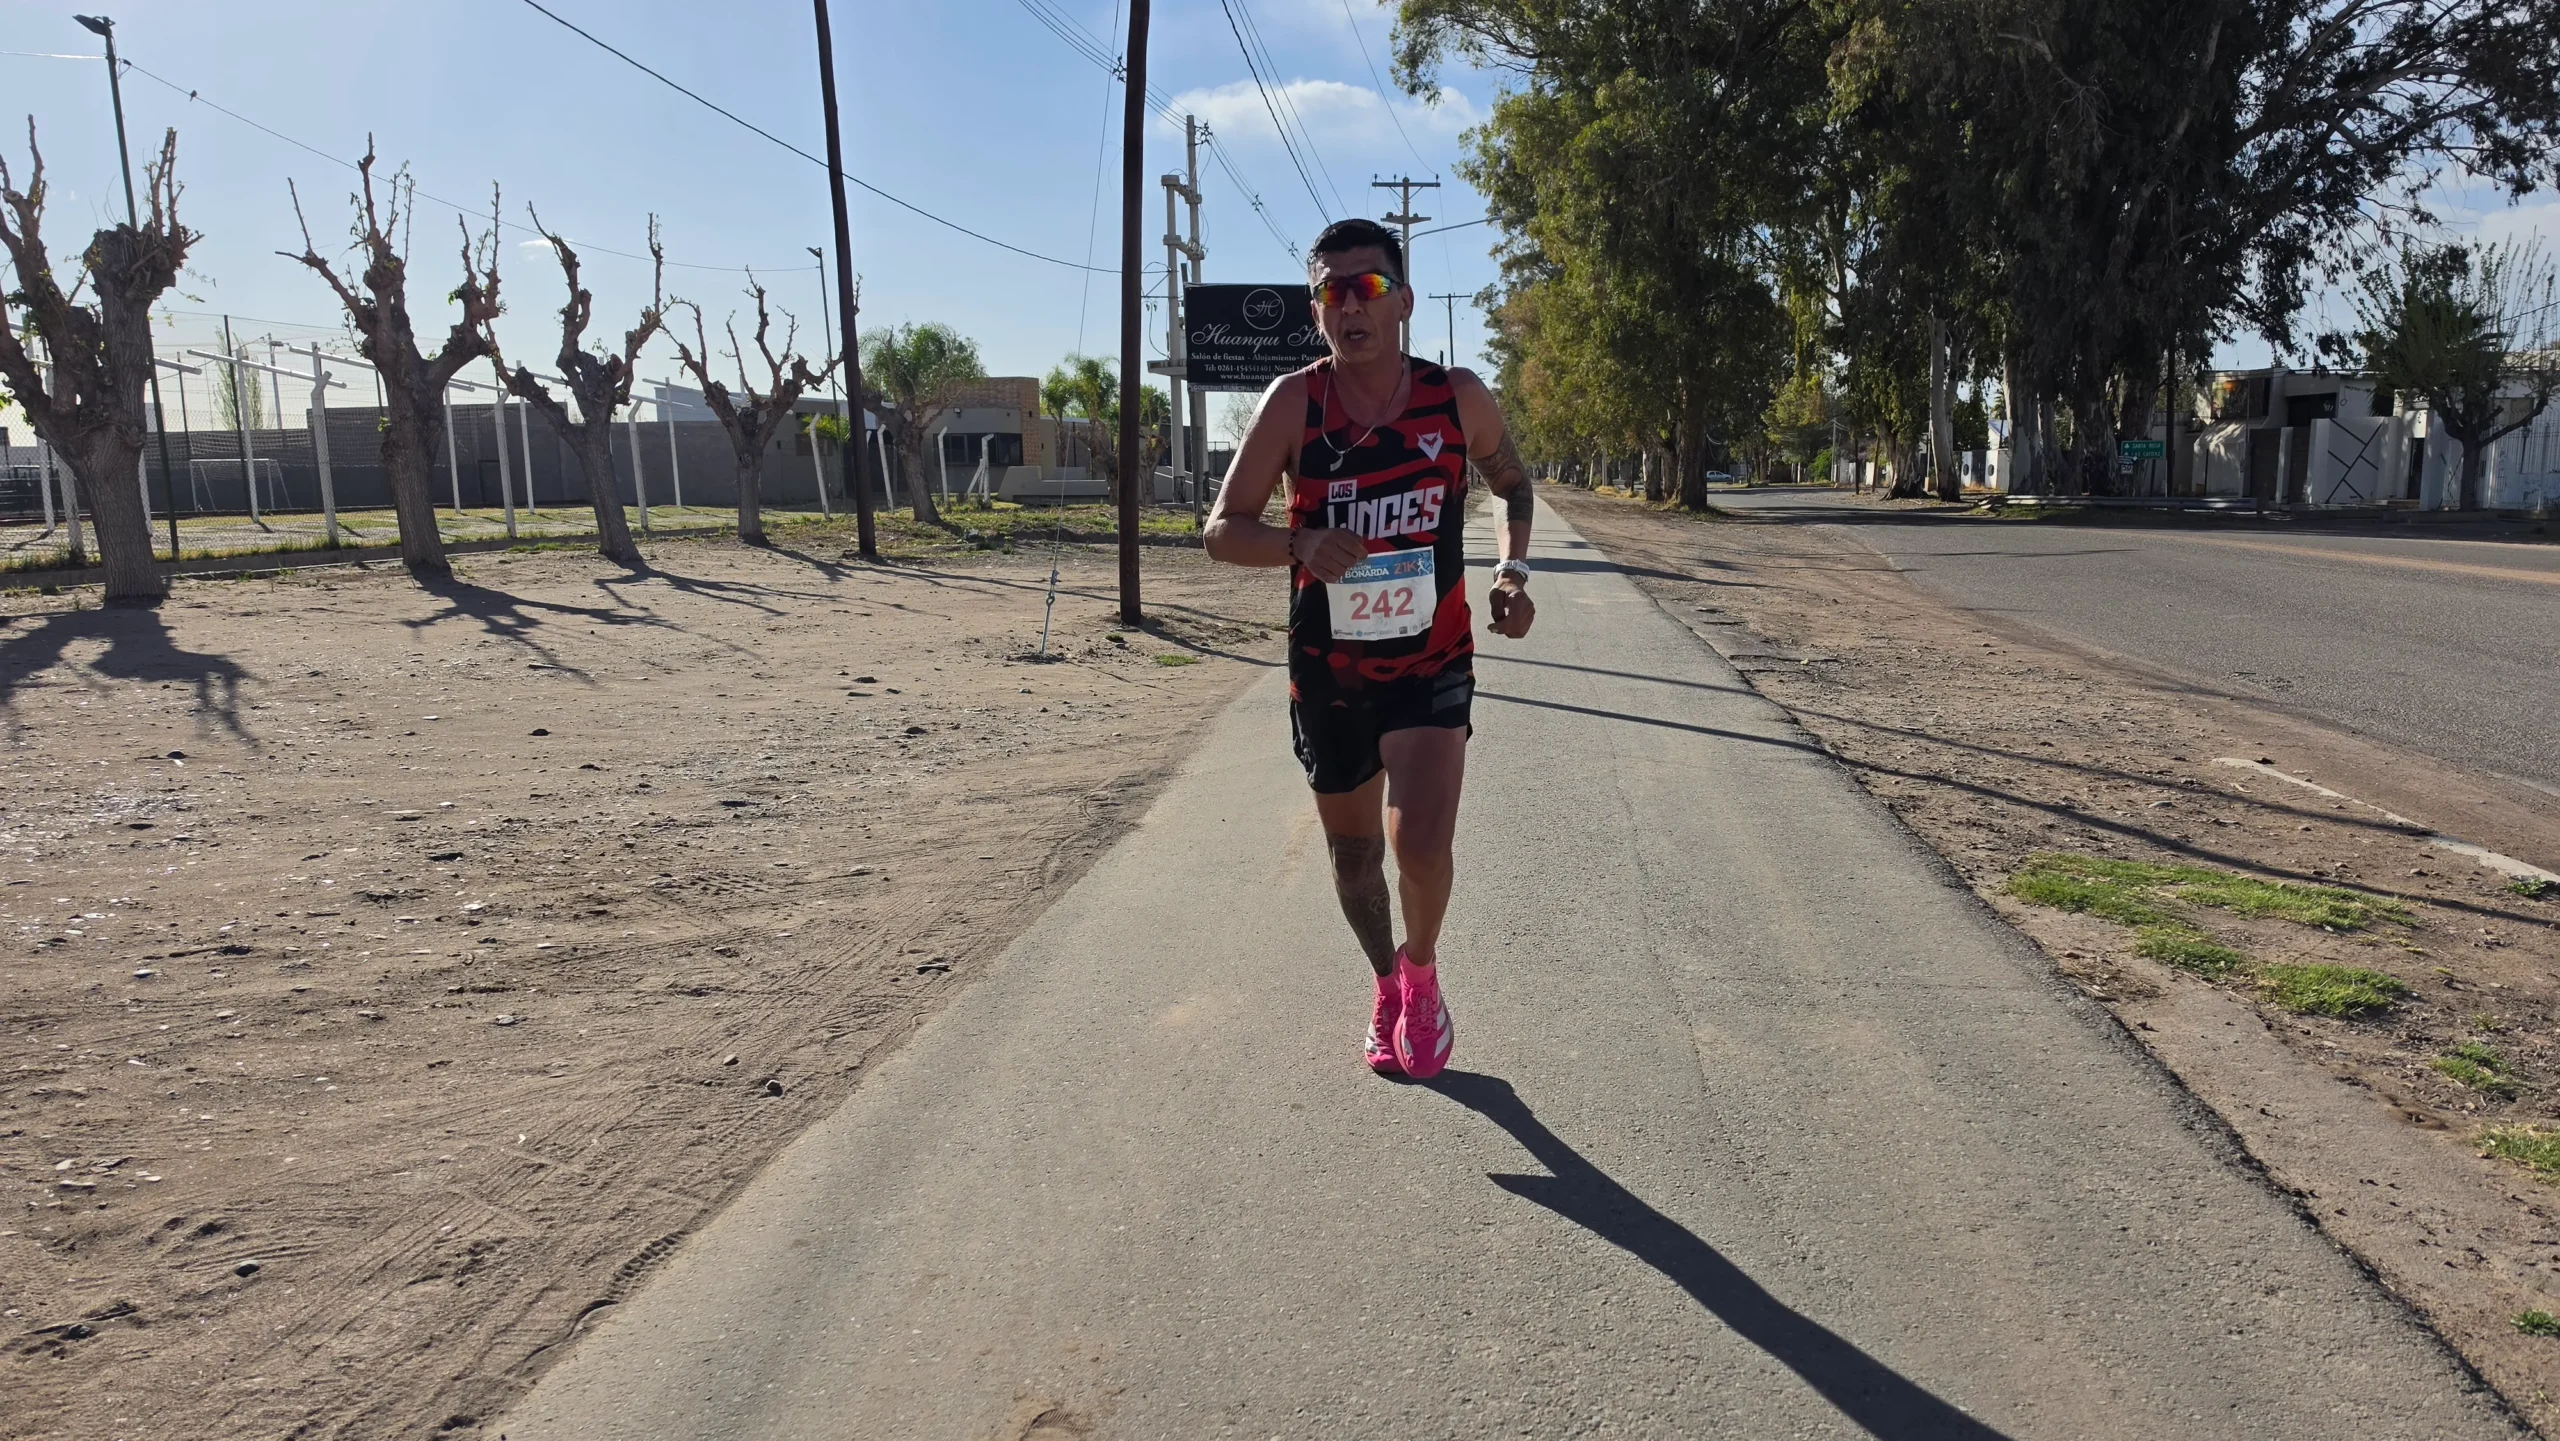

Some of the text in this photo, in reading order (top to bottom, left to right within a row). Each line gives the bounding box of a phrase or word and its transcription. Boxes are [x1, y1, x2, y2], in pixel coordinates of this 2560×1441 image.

[1287, 324, 1329, 347] Hu
[1191, 352, 1211, 360] Salón
[1212, 352, 1222, 360] de
[1223, 352, 1245, 360] fiestas
[1301, 353, 1322, 361] Pastel
[1220, 373, 1277, 381] www.huanquih
[1331, 483, 1353, 499] LOS
[1327, 485, 1445, 541] LINCES
[1345, 568, 1390, 579] BONARDA
[1394, 560, 1417, 575] 21K
[1350, 587, 1414, 620] 242
